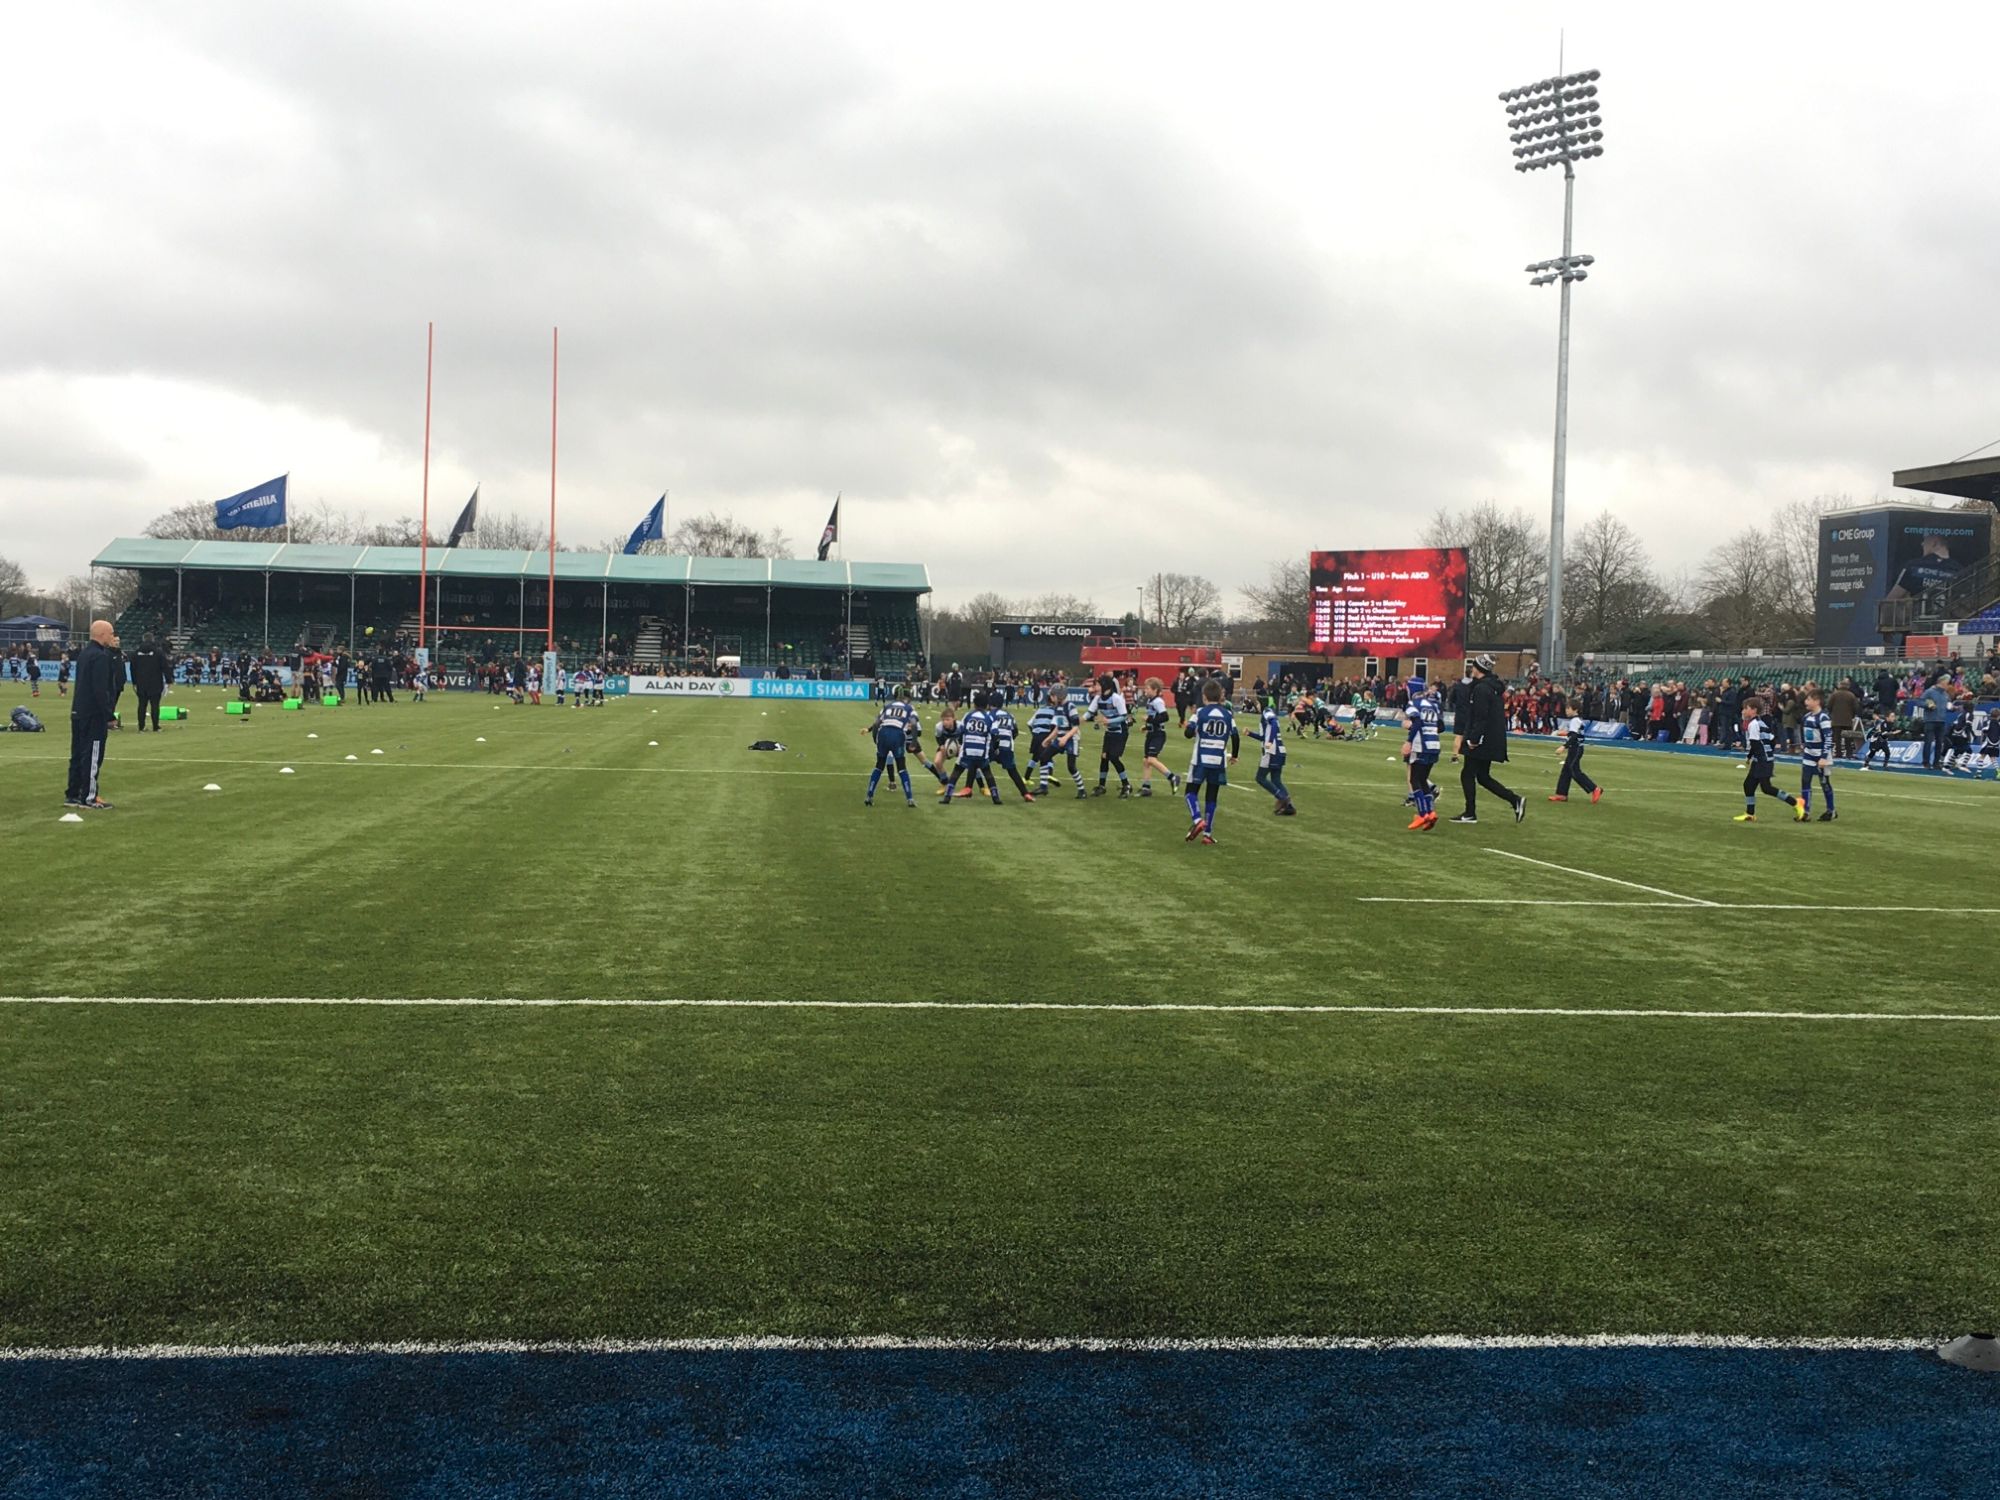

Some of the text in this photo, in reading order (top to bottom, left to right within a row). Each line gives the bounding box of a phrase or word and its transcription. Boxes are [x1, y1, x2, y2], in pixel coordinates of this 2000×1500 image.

[1838, 528, 1875, 541] CME Group
[1904, 526, 1974, 536] cmegroup.com
[1831, 553, 1860, 564] Where the
[1371, 572, 1385, 580] U10
[1830, 565, 1873, 577] world comes to
[1830, 581, 1852, 592] manage
[1030, 626, 1092, 637] CME Group
[646, 680, 716, 691] ALAN DAY
[757, 682, 864, 697] SIMBA SIMBA
[968, 719, 986, 732] 39
[1206, 720, 1225, 736] 40
